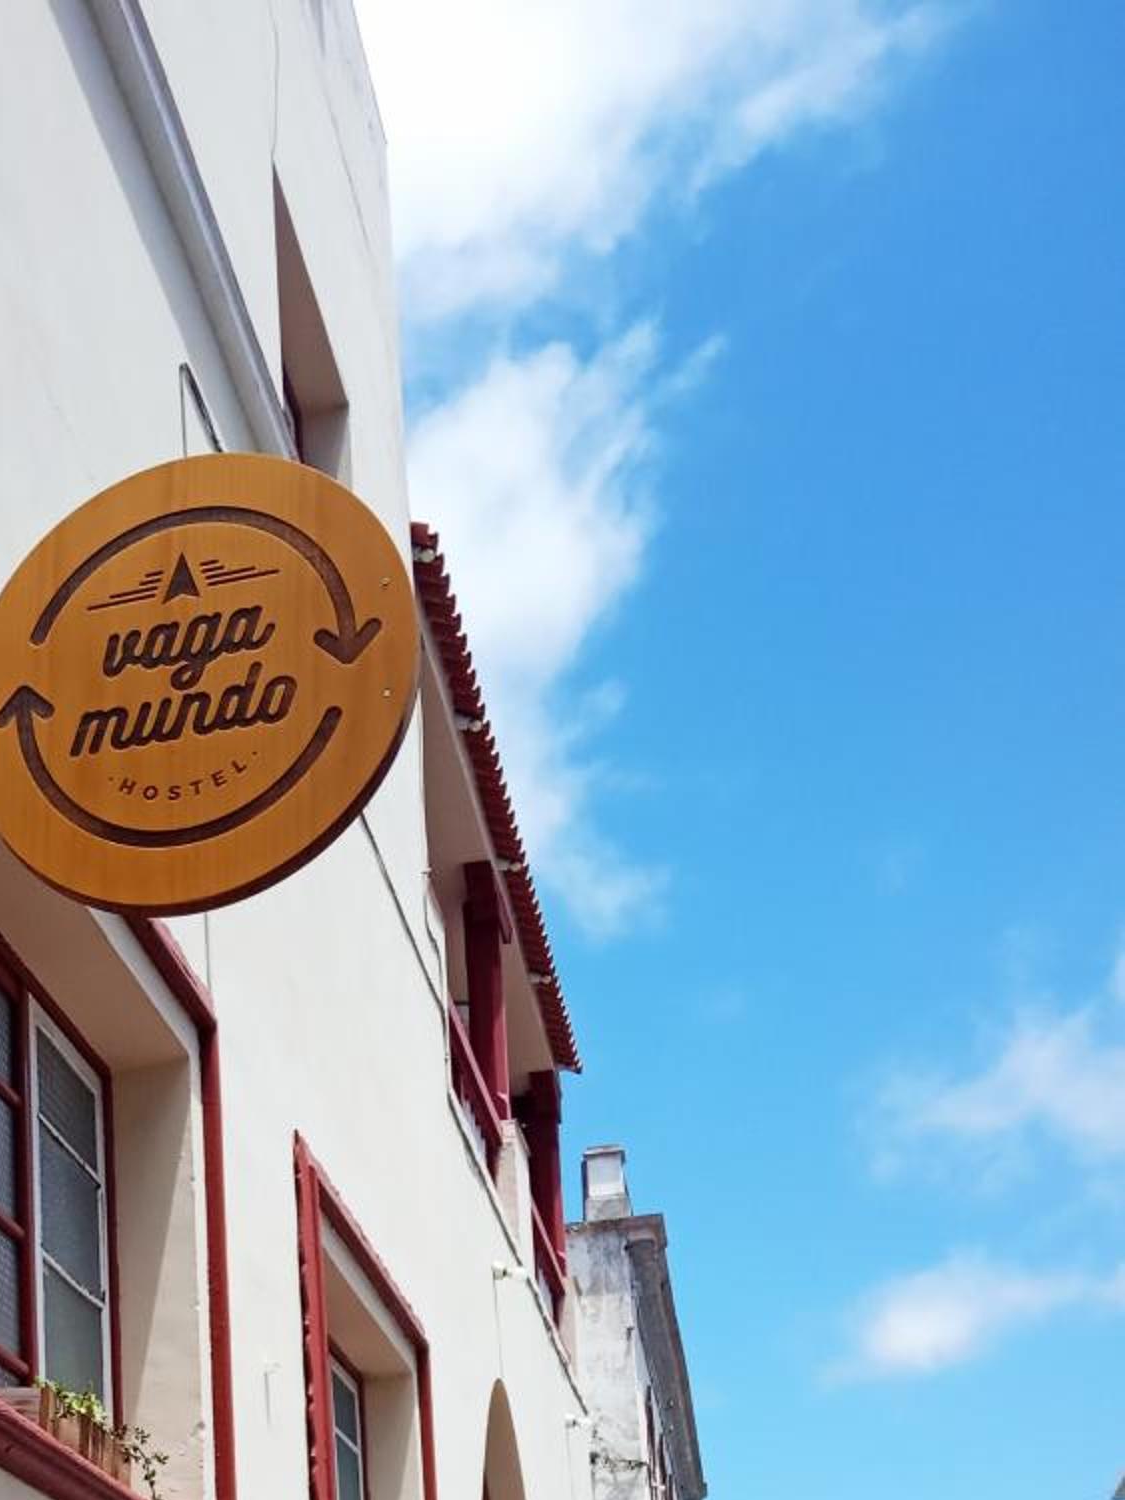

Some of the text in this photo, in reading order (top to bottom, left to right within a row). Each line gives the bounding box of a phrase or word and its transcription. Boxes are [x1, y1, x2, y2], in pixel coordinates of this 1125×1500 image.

[103, 605, 276, 690] vaga
[70, 661, 298, 757] mundo
[118, 758, 248, 801] HOSTEL
